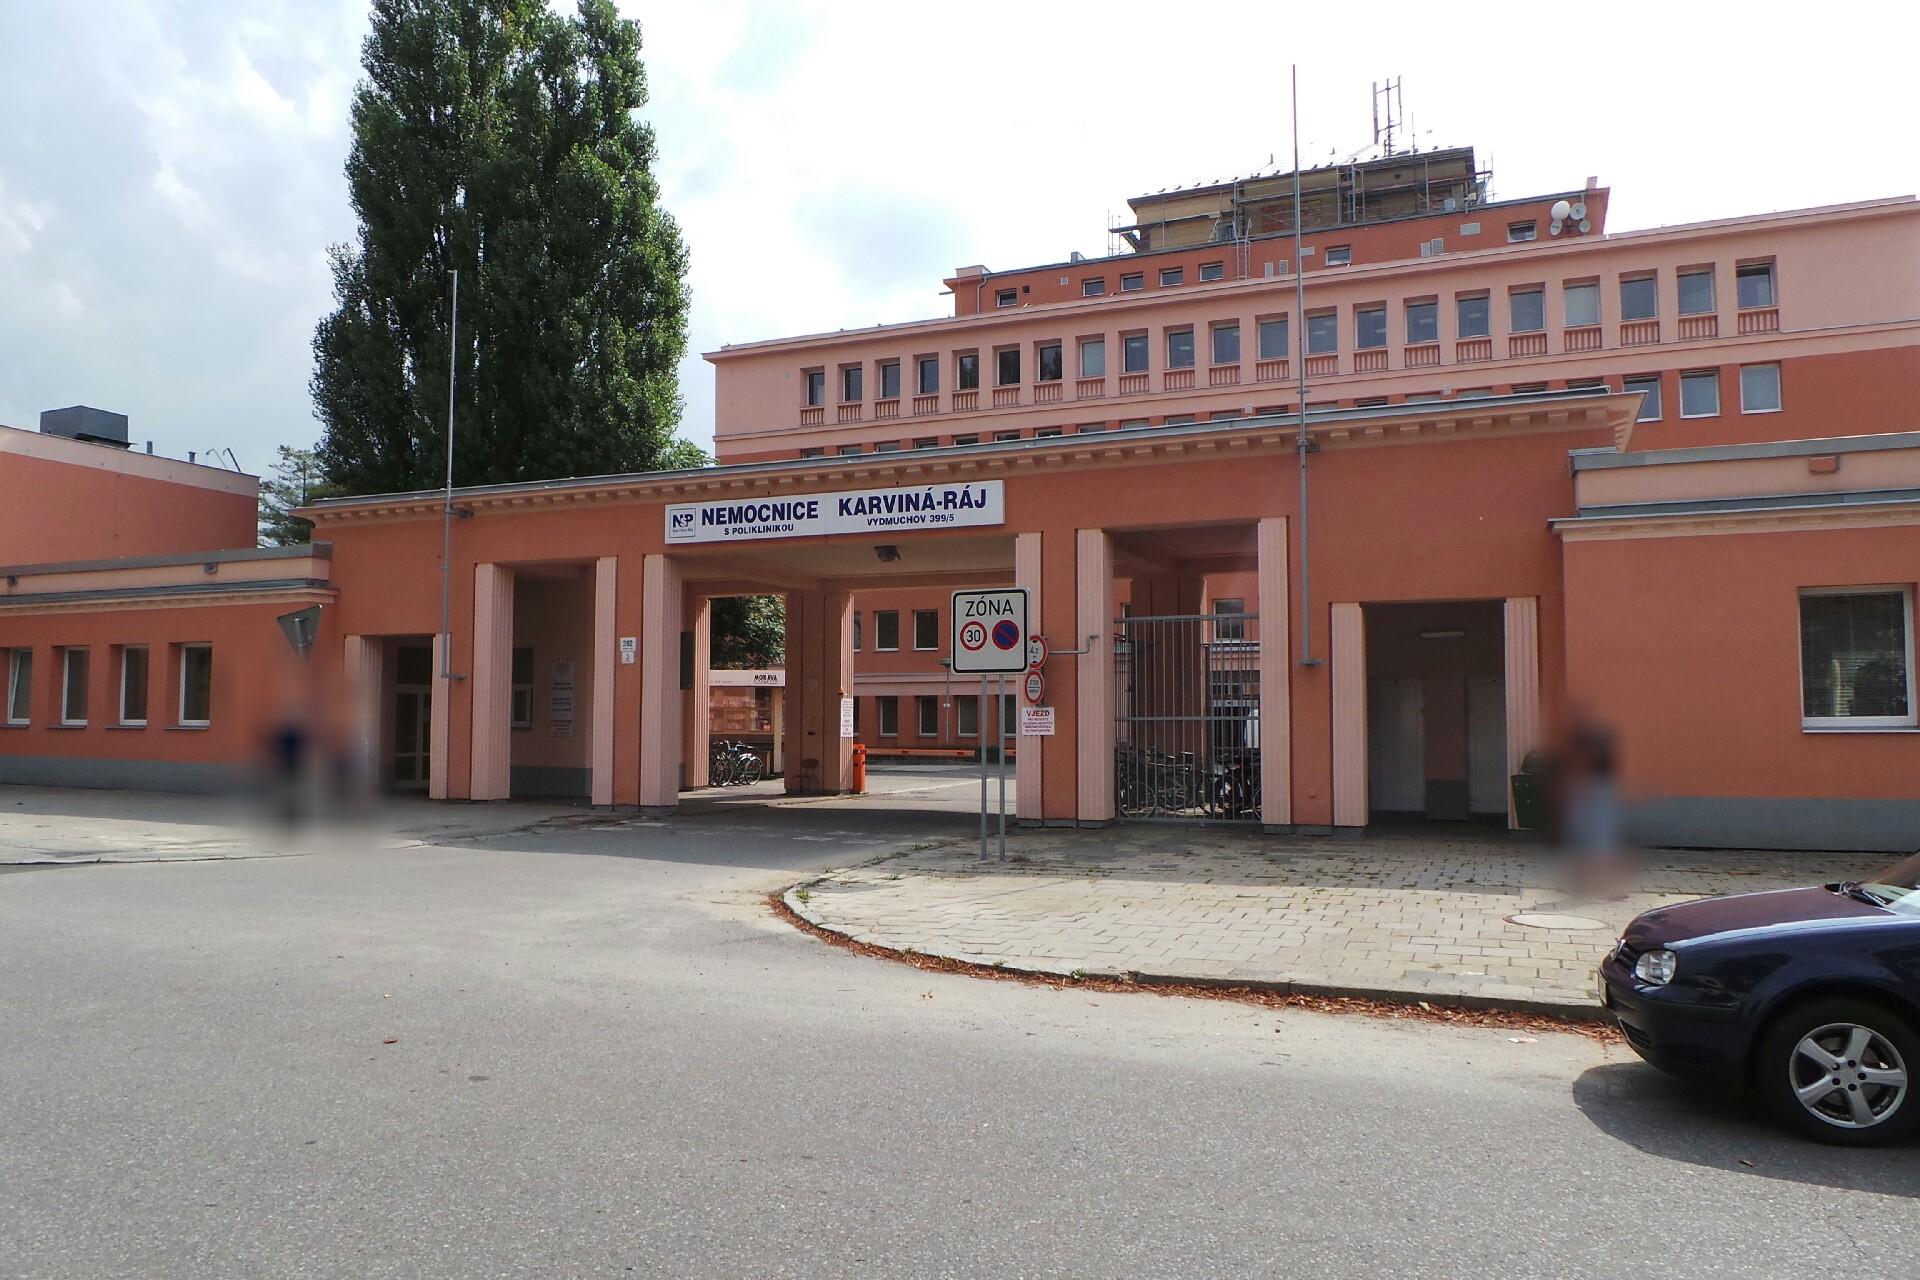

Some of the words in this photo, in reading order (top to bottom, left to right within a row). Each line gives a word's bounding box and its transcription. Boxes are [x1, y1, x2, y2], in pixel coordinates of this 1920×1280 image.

[701, 500, 819, 526] NEMOCNICE
[838, 485, 987, 517] KARVINÁ-RÁJ
[867, 514, 926, 526] VYDMUCHOV
[929, 513, 955, 523] 399/5
[724, 527, 730, 536] S
[732, 523, 794, 534] POLIKLINIKOU
[965, 596, 1014, 617] ZÓNA
[966, 629, 981, 643] 30
